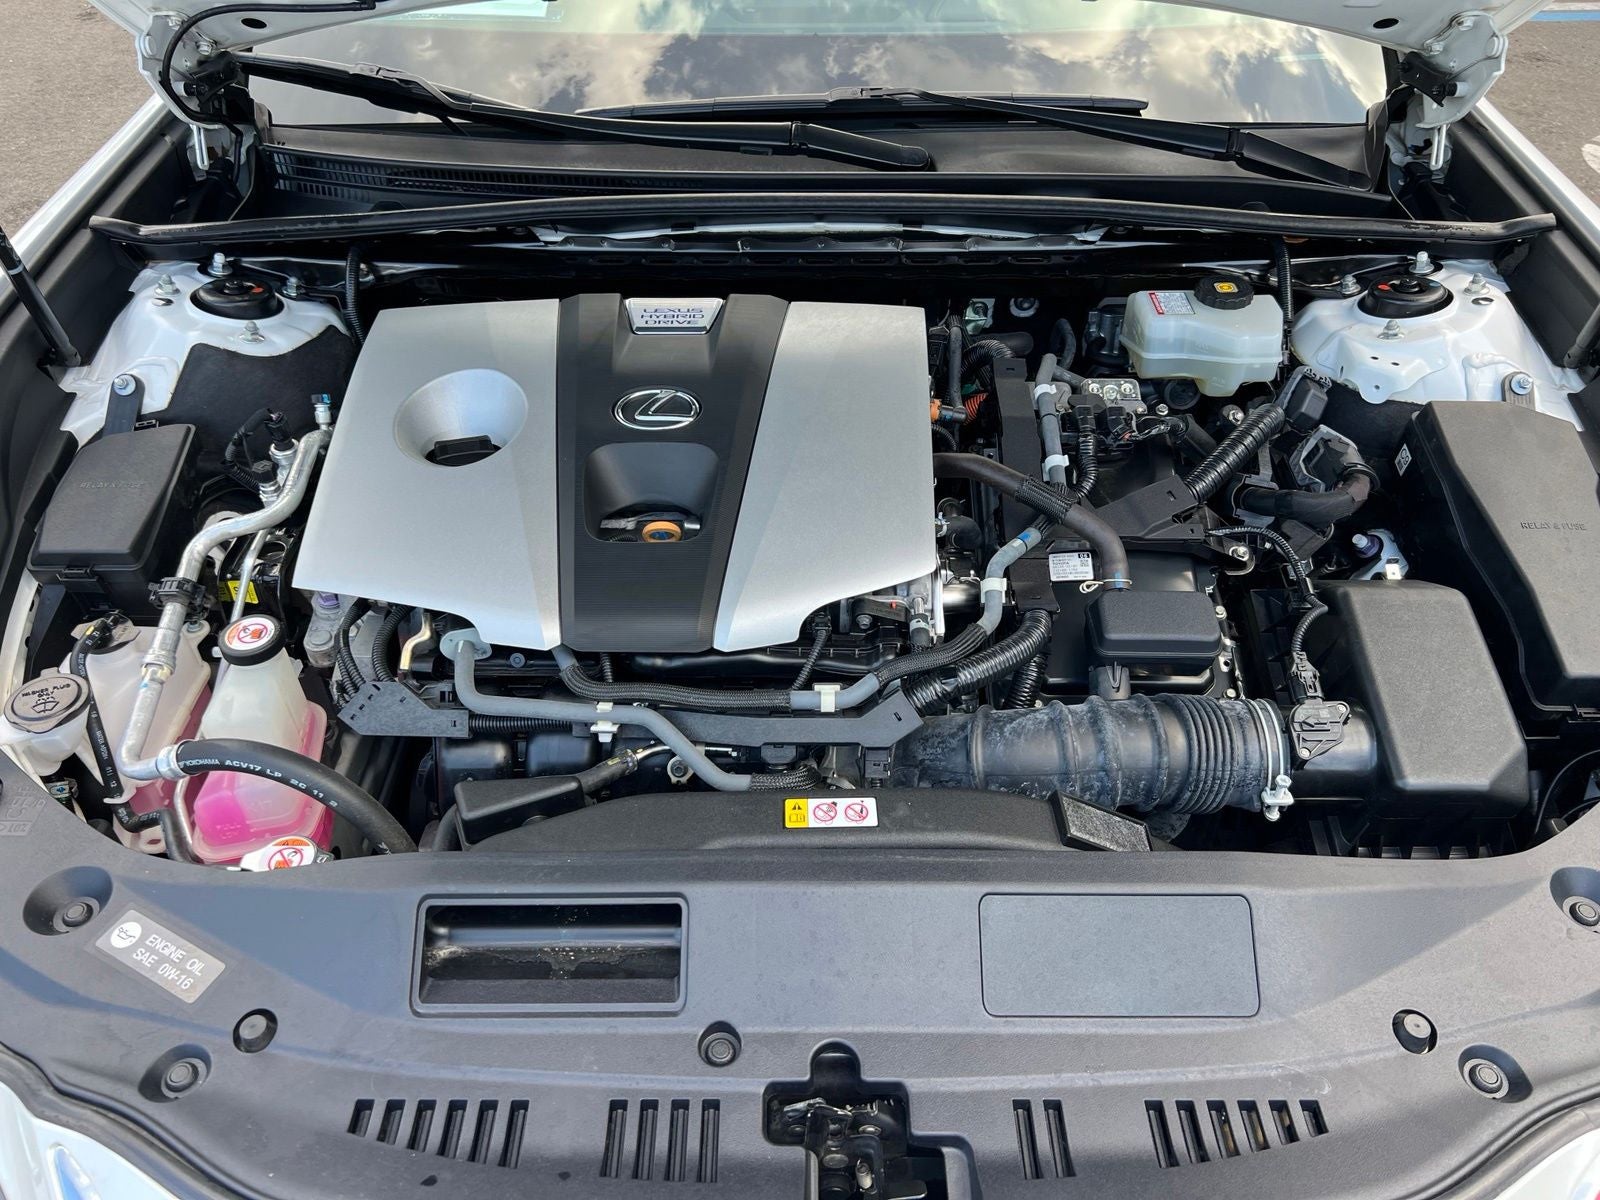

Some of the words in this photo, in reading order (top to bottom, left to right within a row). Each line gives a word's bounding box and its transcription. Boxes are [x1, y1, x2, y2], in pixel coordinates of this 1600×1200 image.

[1520, 521, 1551, 530] RELAY
[1561, 521, 1587, 531] FUSE
[22, 687, 49, 697] WASHER
[37, 690, 54, 698] ONLY
[224, 759, 262, 772] ACV17
[266, 768, 283, 778] LP
[145, 934, 187, 963] ENGINE
[185, 958, 205, 977] OIL
[132, 947, 159, 968] SAE
[157, 963, 194, 990] 0W-16
